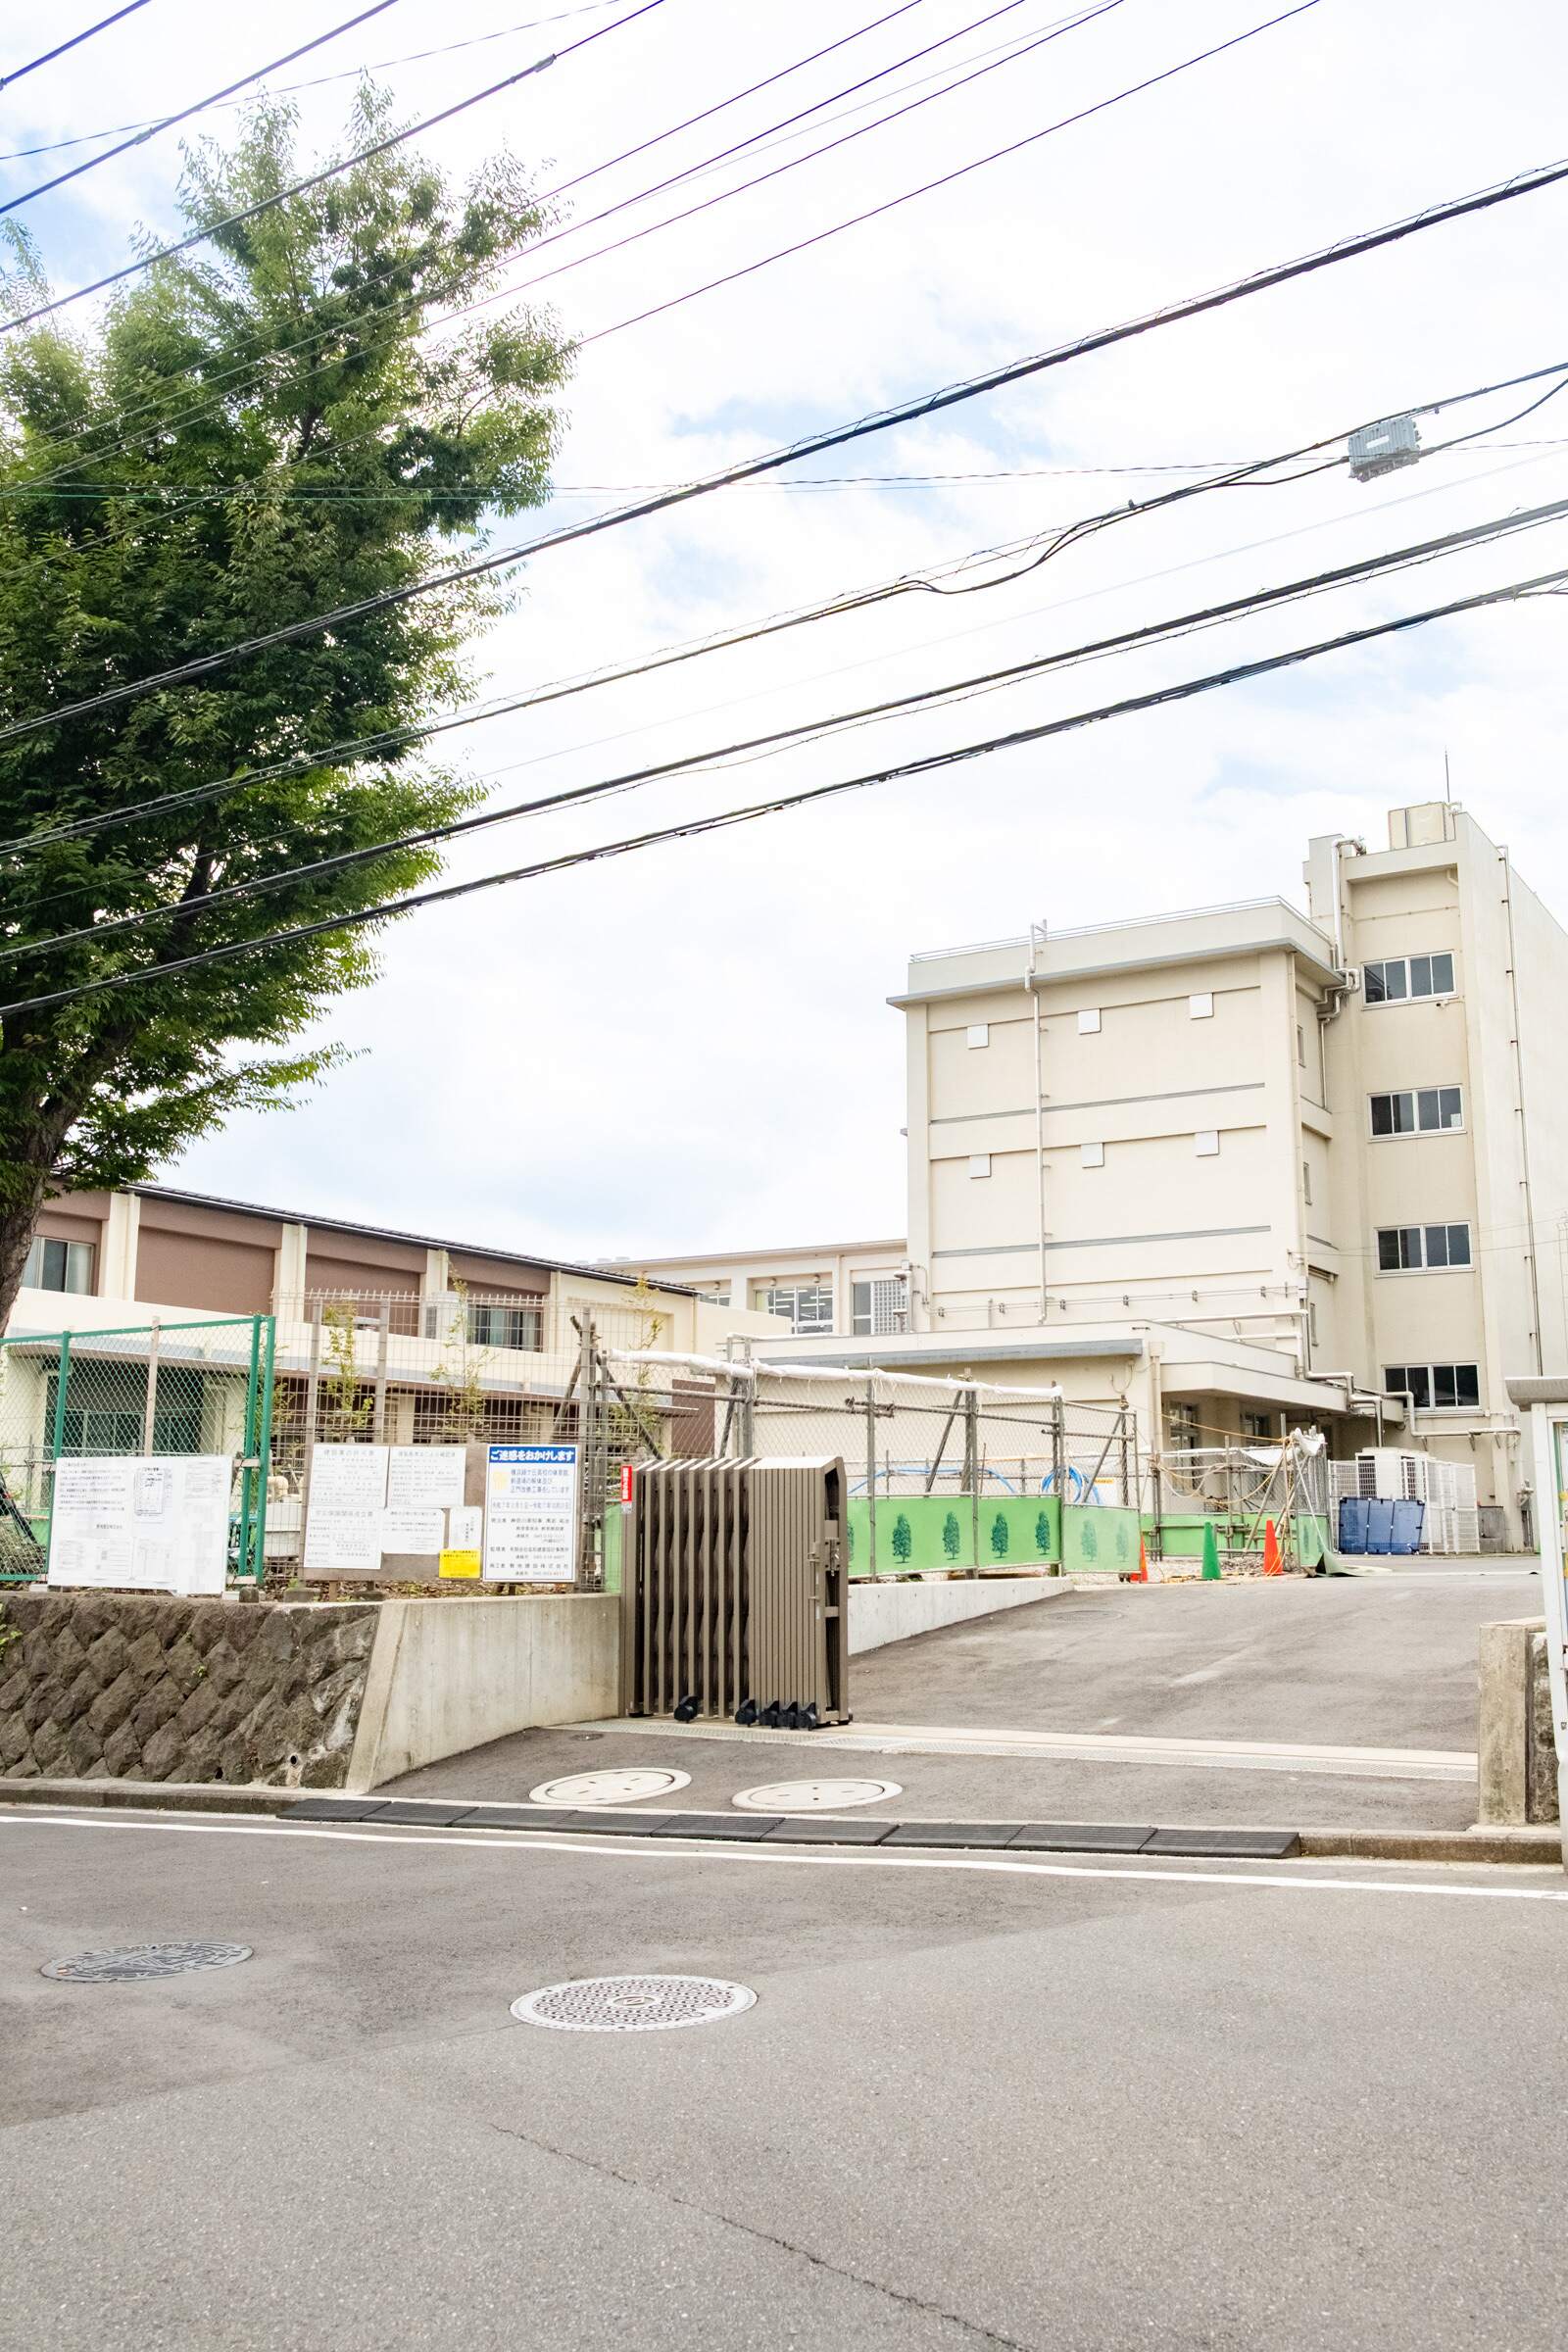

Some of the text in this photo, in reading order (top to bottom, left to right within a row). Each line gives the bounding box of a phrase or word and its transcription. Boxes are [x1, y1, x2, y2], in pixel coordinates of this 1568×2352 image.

[490, 1449, 574, 1461] ご迷惑をおかけします
